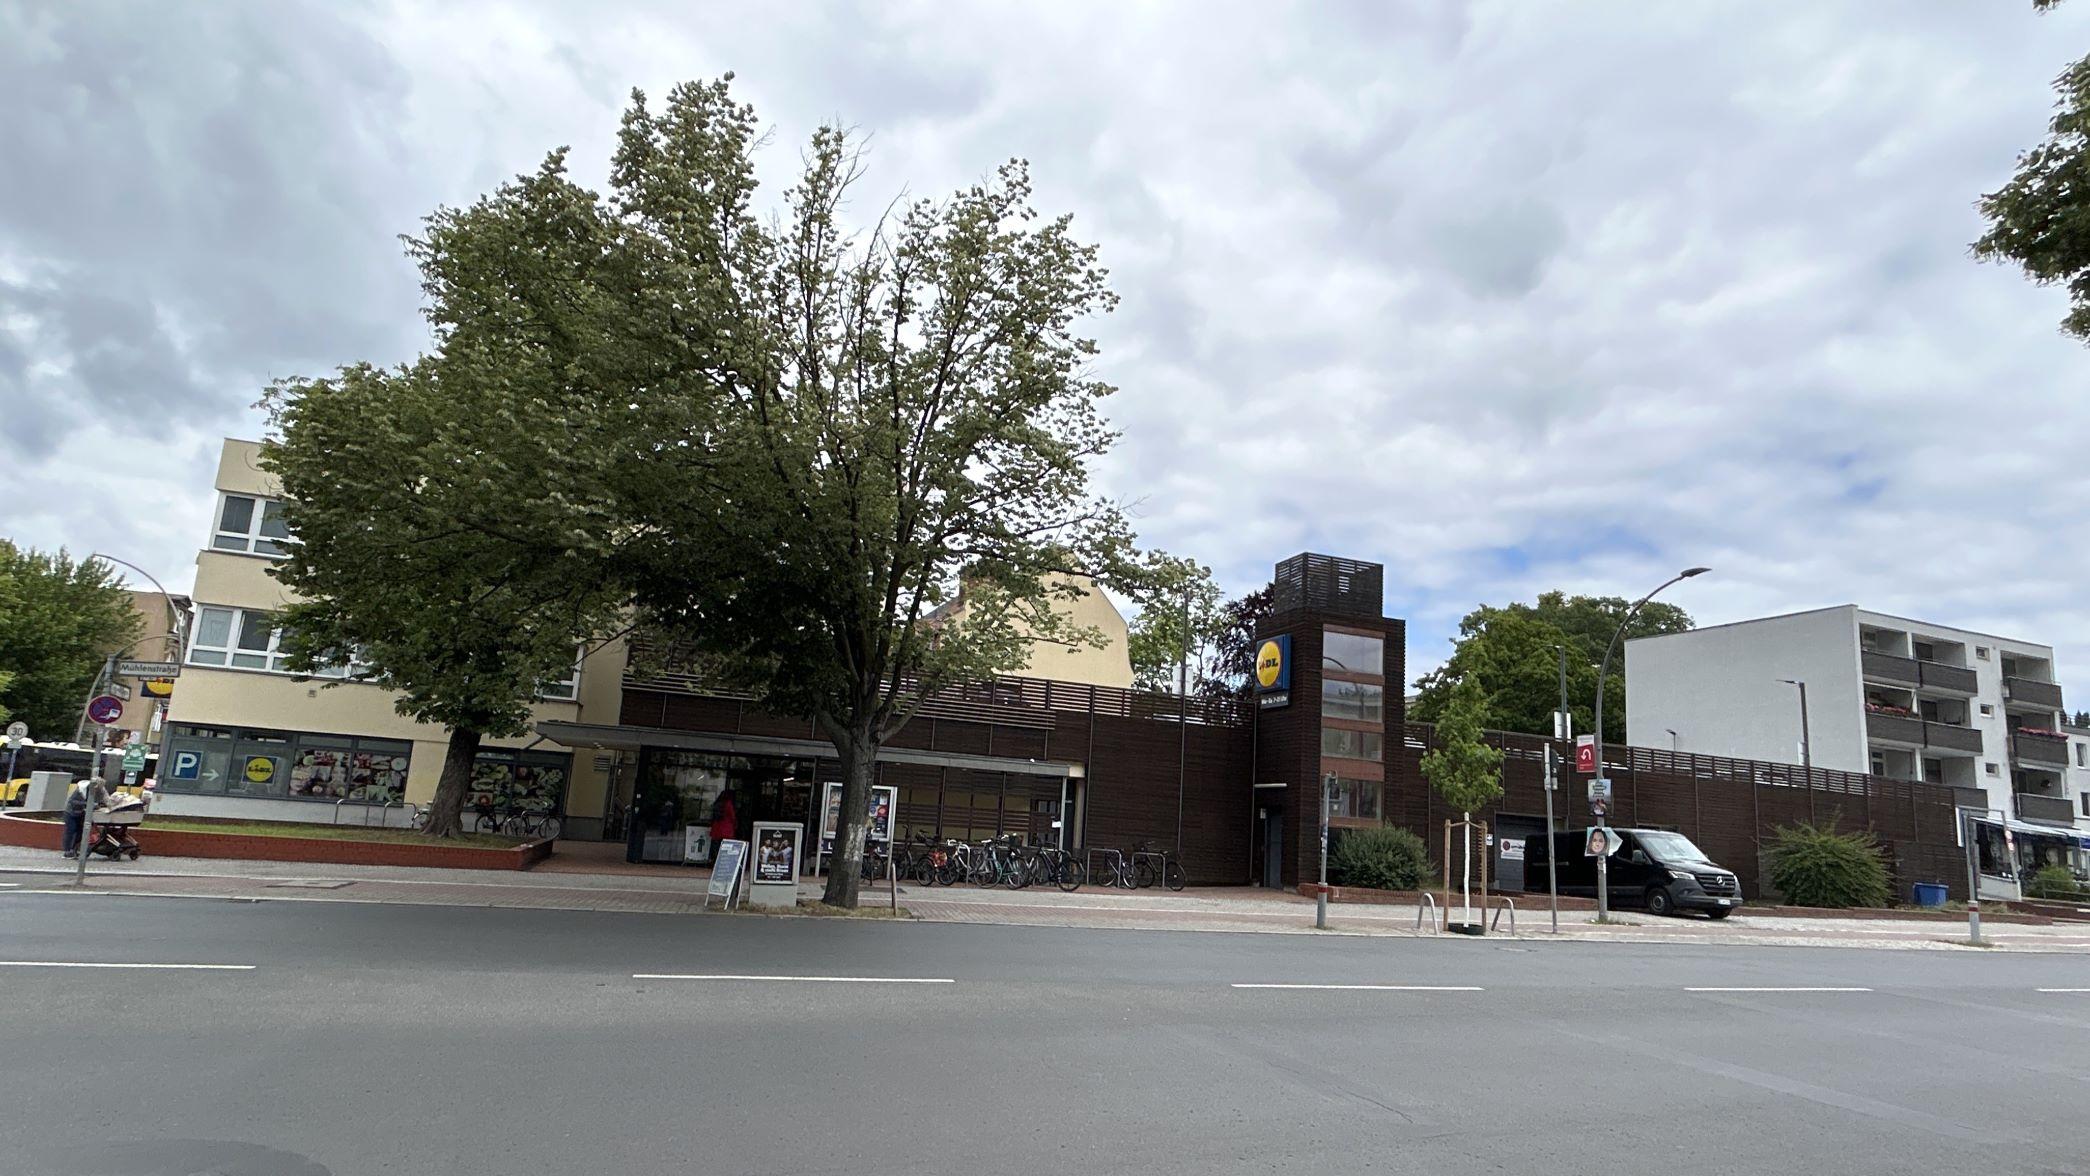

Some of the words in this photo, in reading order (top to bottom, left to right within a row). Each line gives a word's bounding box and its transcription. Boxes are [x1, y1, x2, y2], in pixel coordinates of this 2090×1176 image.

[121, 664, 177, 675] Mühlenstraße
[11, 727, 23, 736] 30
[174, 752, 197, 776] P
